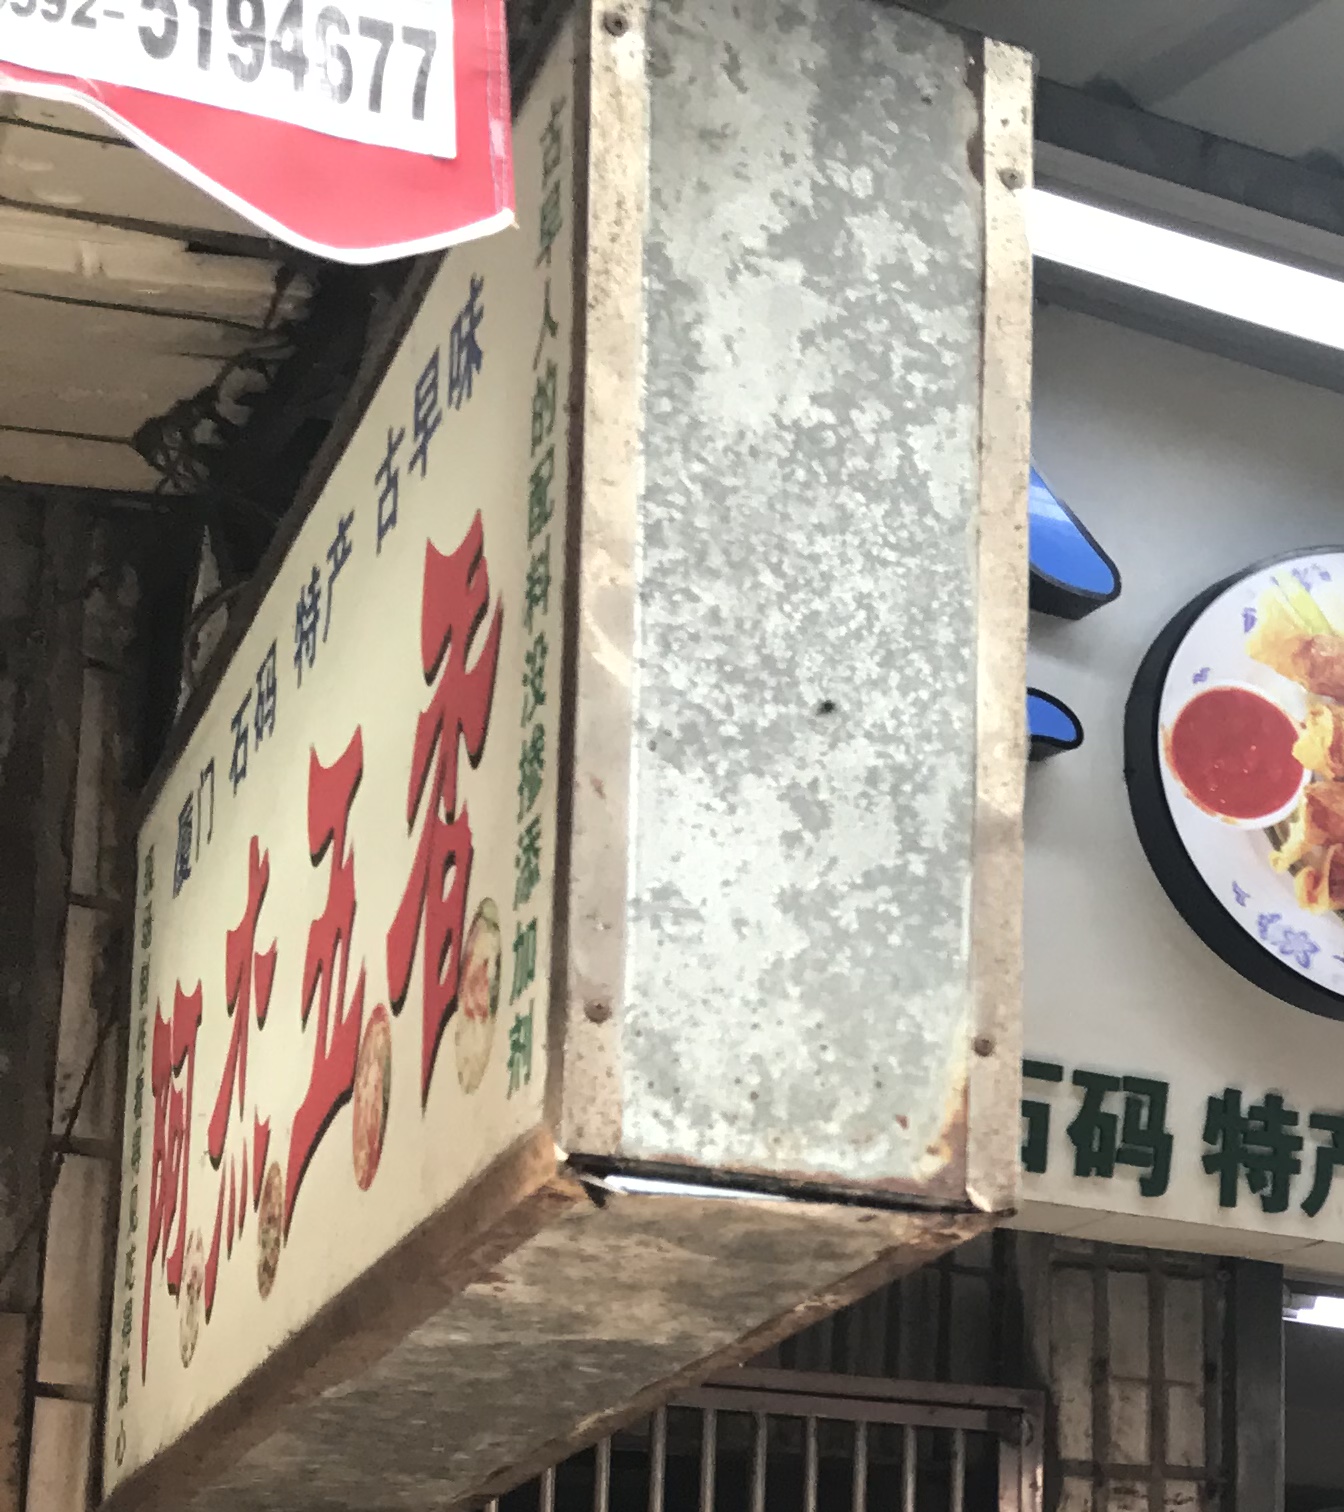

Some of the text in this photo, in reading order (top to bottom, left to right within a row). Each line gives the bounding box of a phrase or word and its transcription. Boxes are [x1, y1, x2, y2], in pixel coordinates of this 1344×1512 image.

[0, 0, 437, 121] 92-5194677
[293, 511, 355, 689] 特产
[373, 272, 488, 558] 古早味
[142, 508, 504, 1387] 阿杰五香
